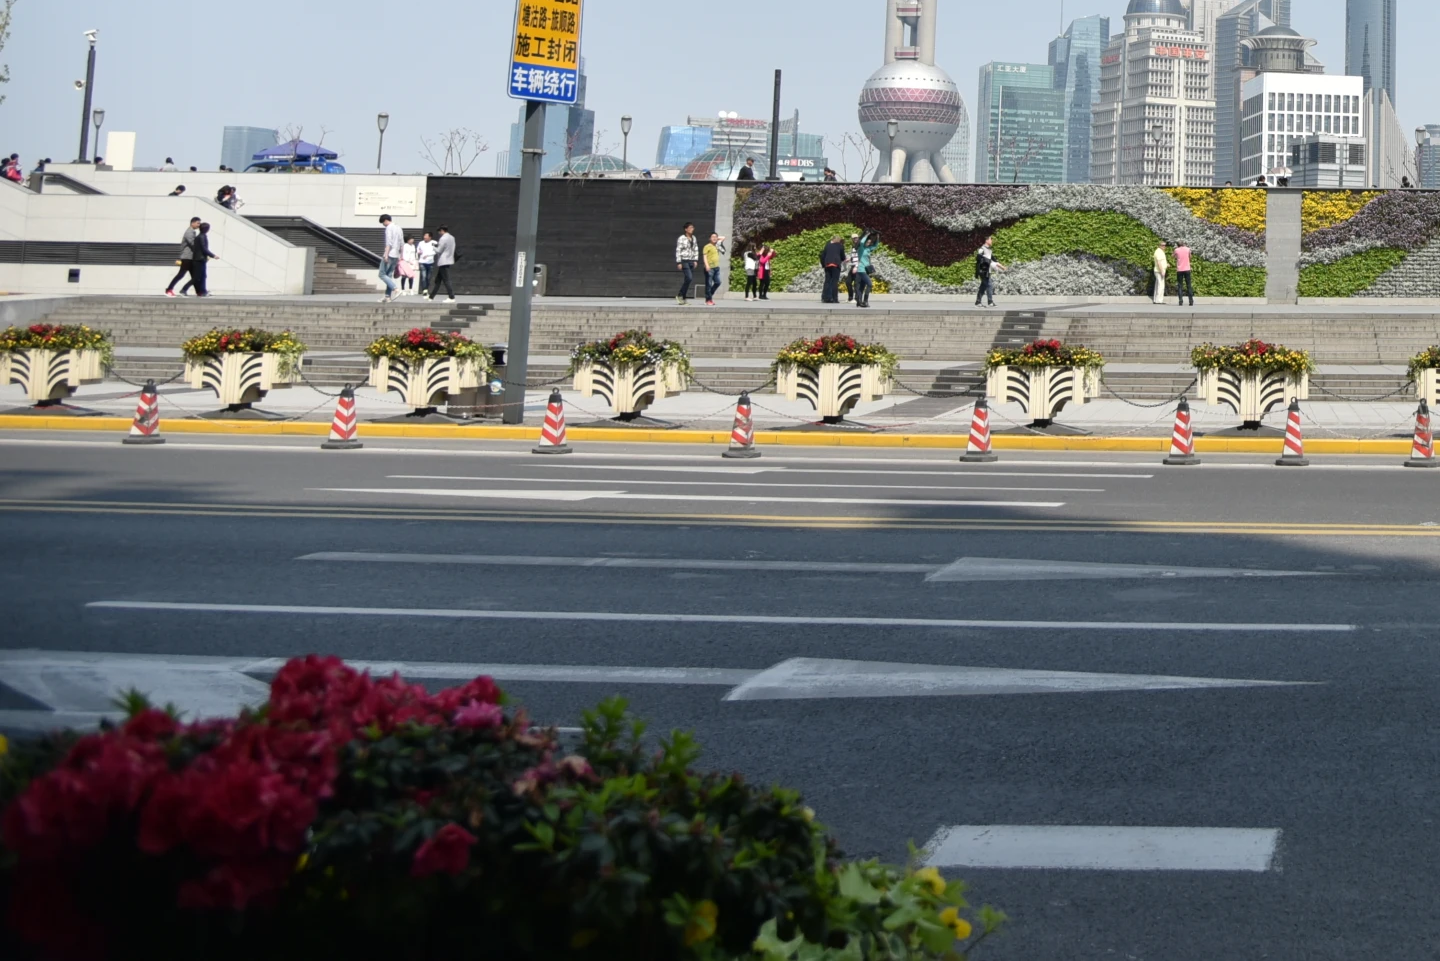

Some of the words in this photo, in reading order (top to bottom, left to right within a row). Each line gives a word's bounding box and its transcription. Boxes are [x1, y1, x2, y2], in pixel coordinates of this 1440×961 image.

[515, 33, 577, 64] 施工封闭
[1155, 46, 1206, 59] 中国平安
[997, 64, 1027, 74] 汇亚大厦
[512, 67, 575, 98] 车辆绕行
[797, 158, 815, 167] DBS
